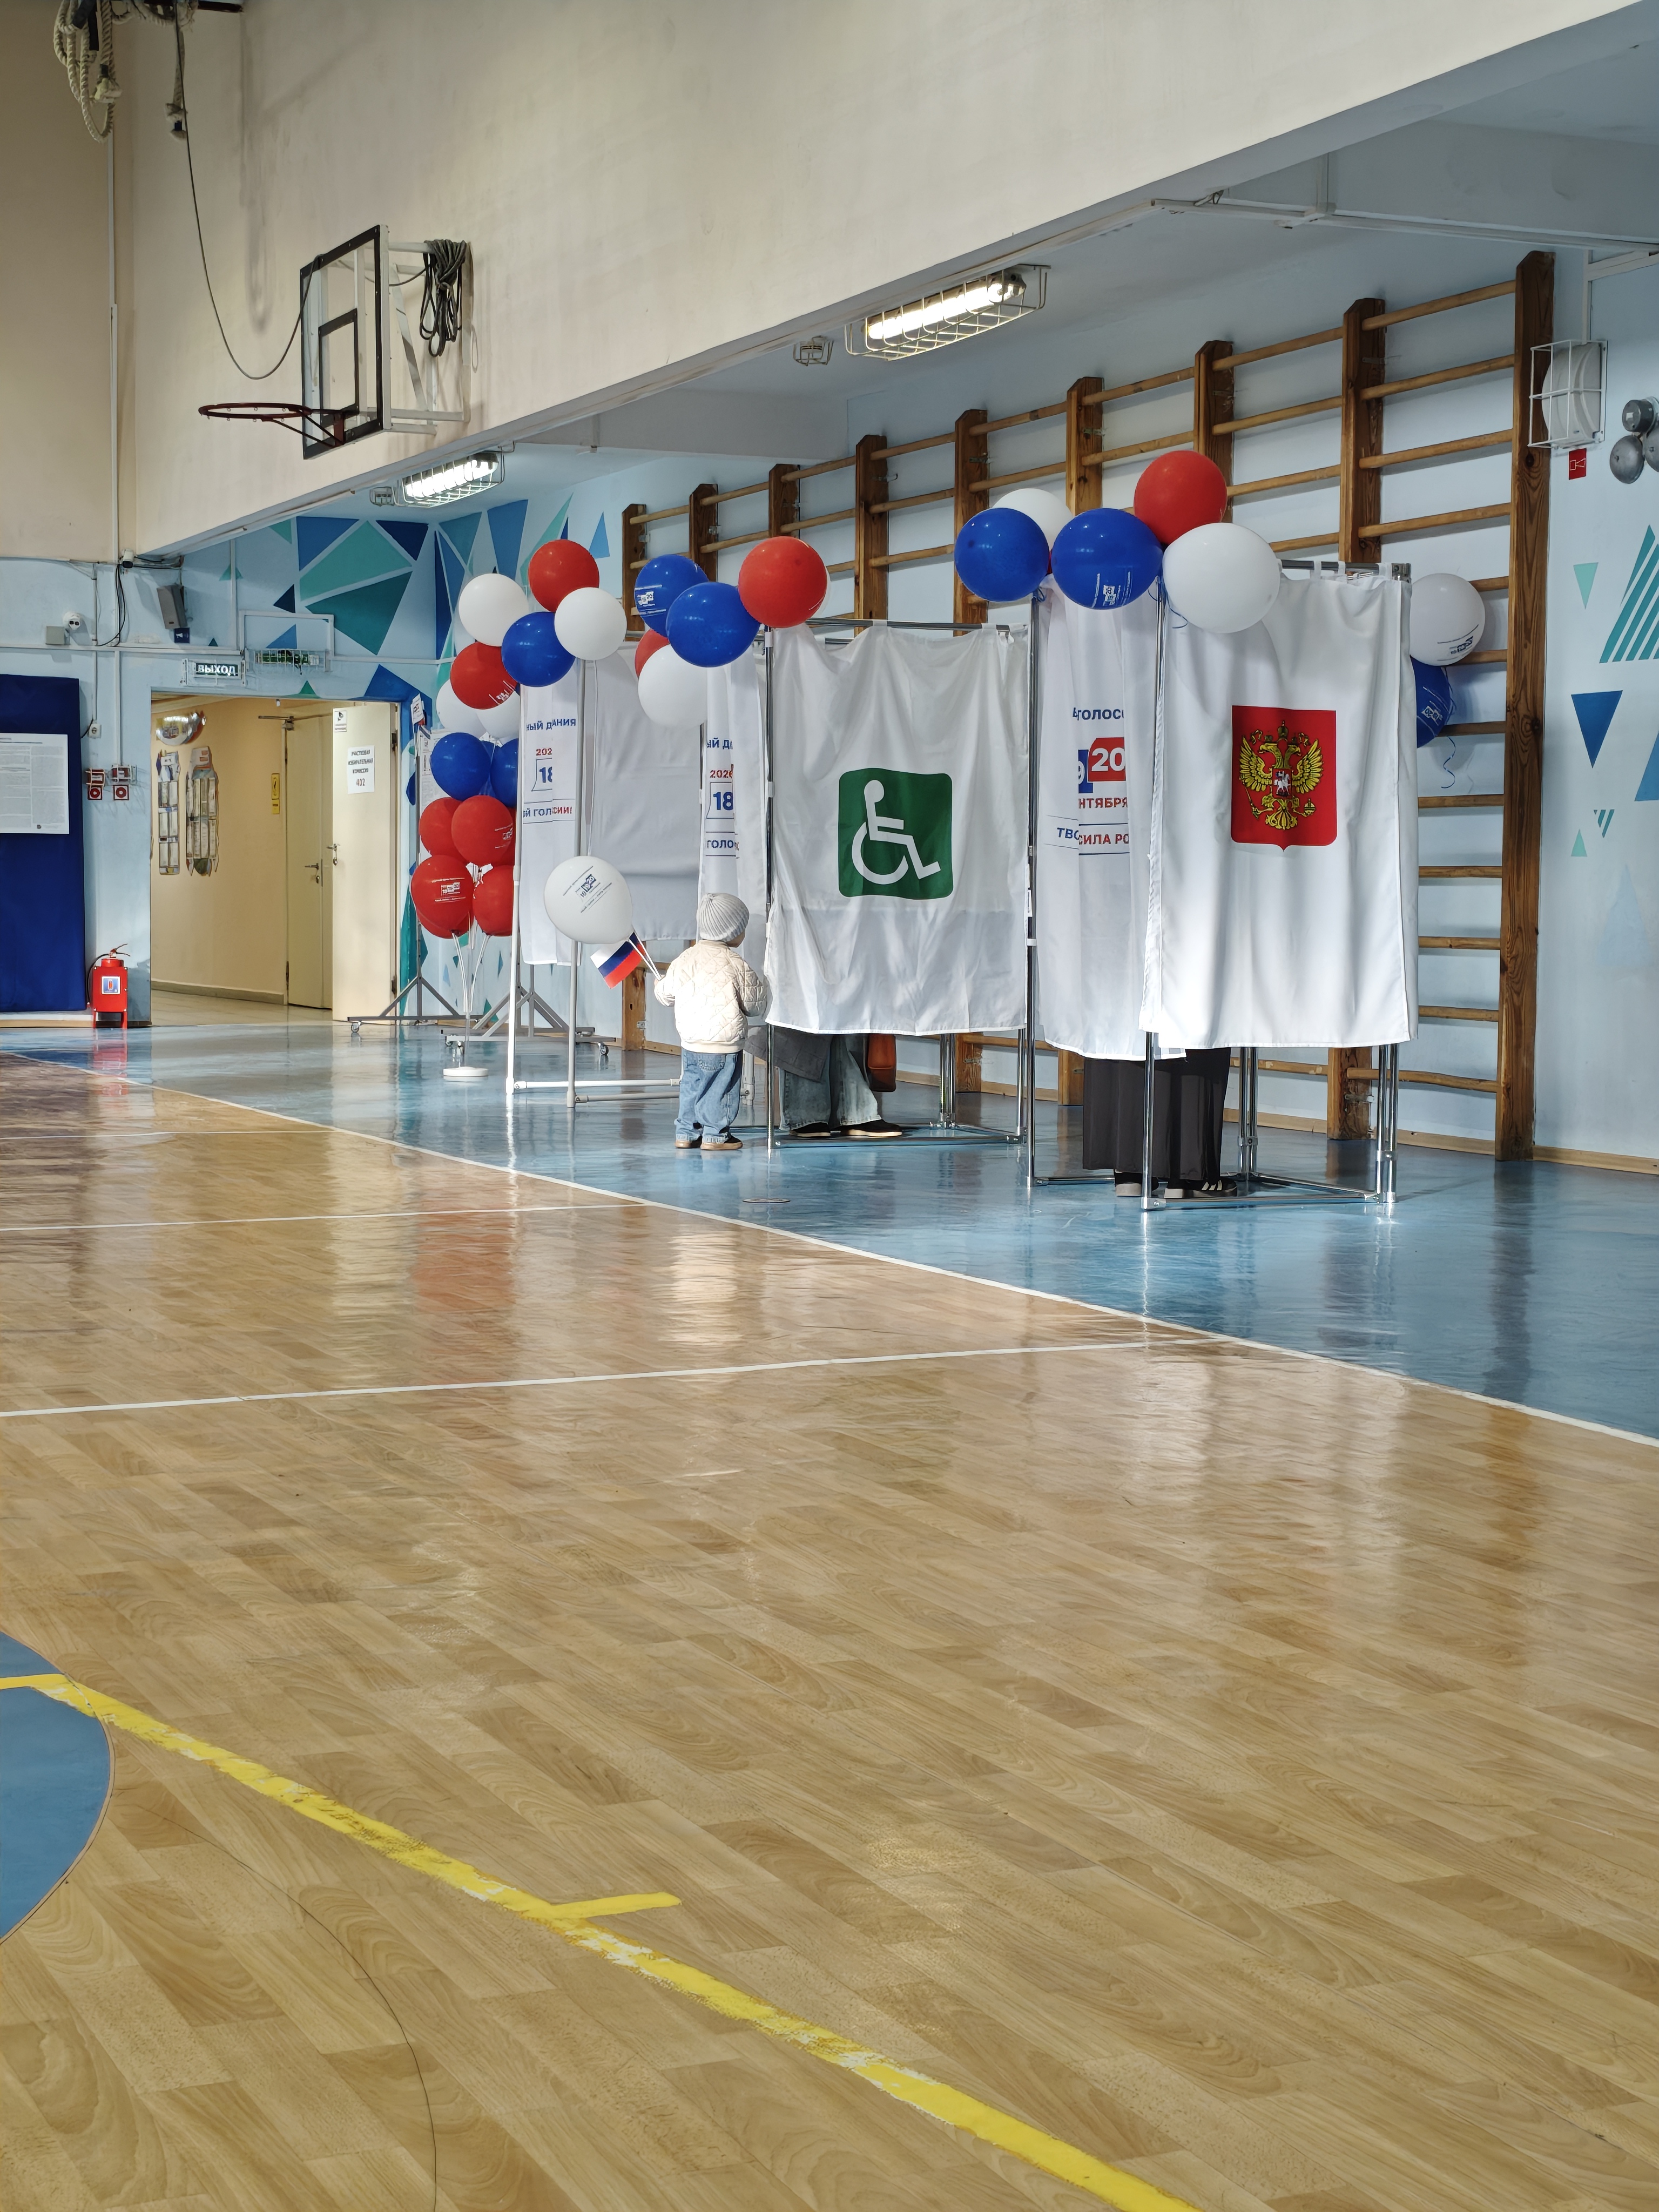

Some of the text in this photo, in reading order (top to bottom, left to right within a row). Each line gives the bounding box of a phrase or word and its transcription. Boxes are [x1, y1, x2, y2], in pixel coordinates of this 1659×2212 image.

[198, 664, 236, 676] ВЫХОД
[1077, 709, 1124, 720] ГОЛОС
[1091, 747, 1125, 772] 20
[713, 791, 734, 811] 18
